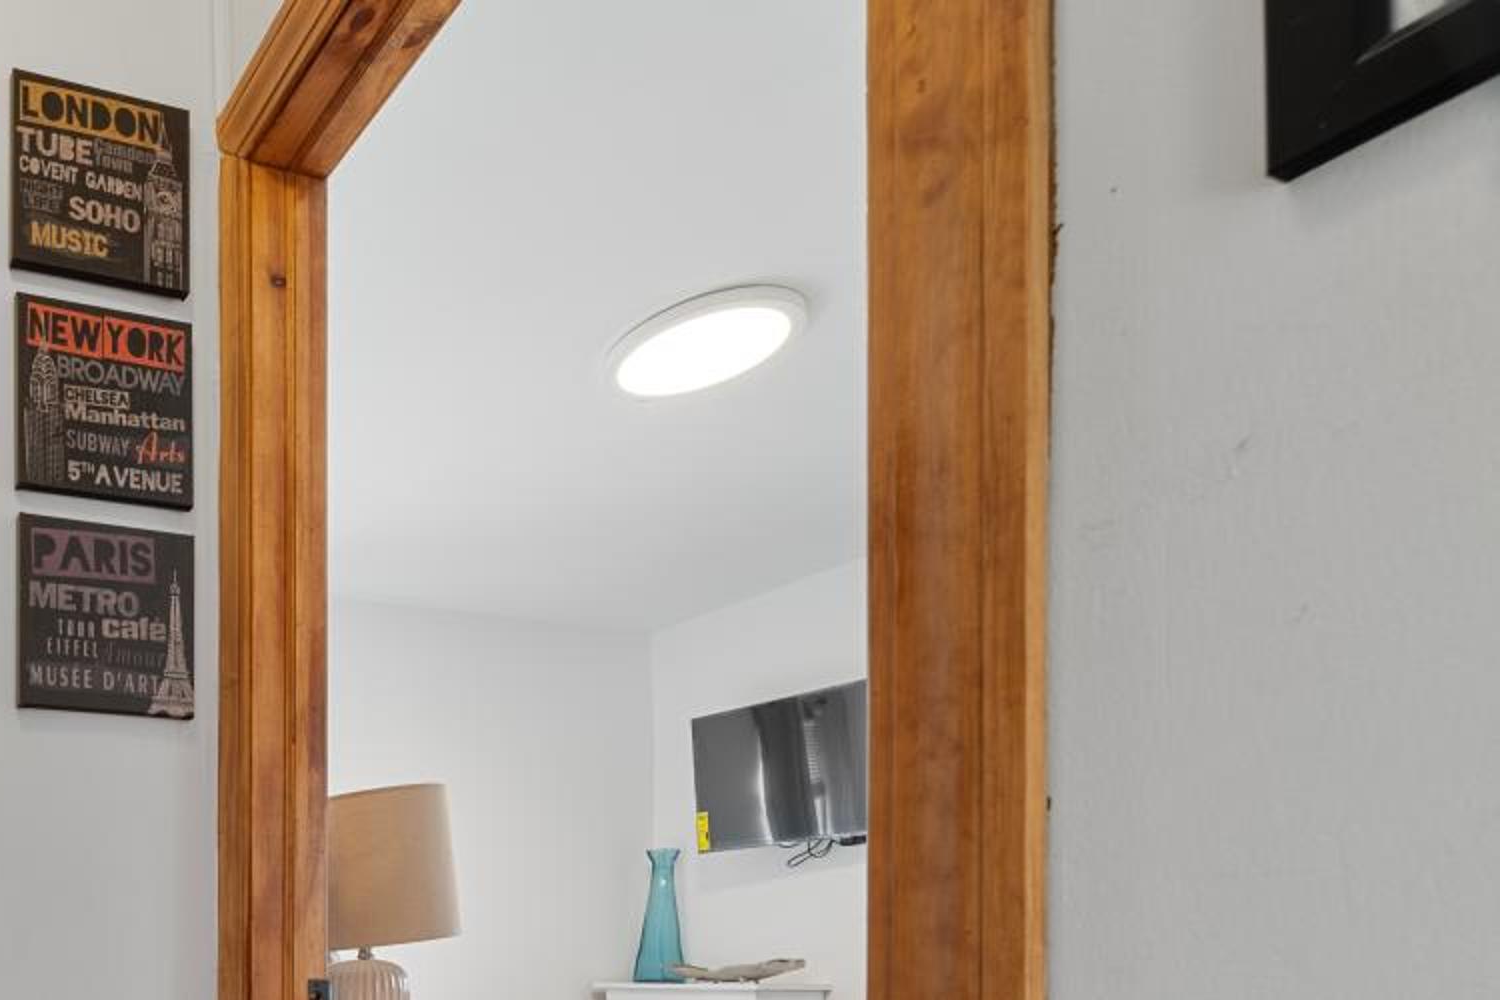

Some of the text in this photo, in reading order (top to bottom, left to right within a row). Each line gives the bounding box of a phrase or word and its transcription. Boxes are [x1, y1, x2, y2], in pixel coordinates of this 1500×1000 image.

[21, 84, 160, 145] LONDON
[17, 125, 94, 166] TUBE
[19, 154, 143, 202] COVENT GARDEN
[68, 196, 141, 233] SOHO
[30, 221, 109, 258] MUSIC
[29, 307, 183, 367] NEW YORK
[56, 355, 185, 396] BROADWAY
[65, 386, 130, 409] CHELSEA
[64, 402, 185, 431] Manhattan
[66, 429, 130, 457] SUBWAY
[135, 432, 185, 465] Arts
[95, 465, 184, 494] AVENUE
[33, 532, 151, 577] PARIS
[28, 580, 140, 617] METRO
